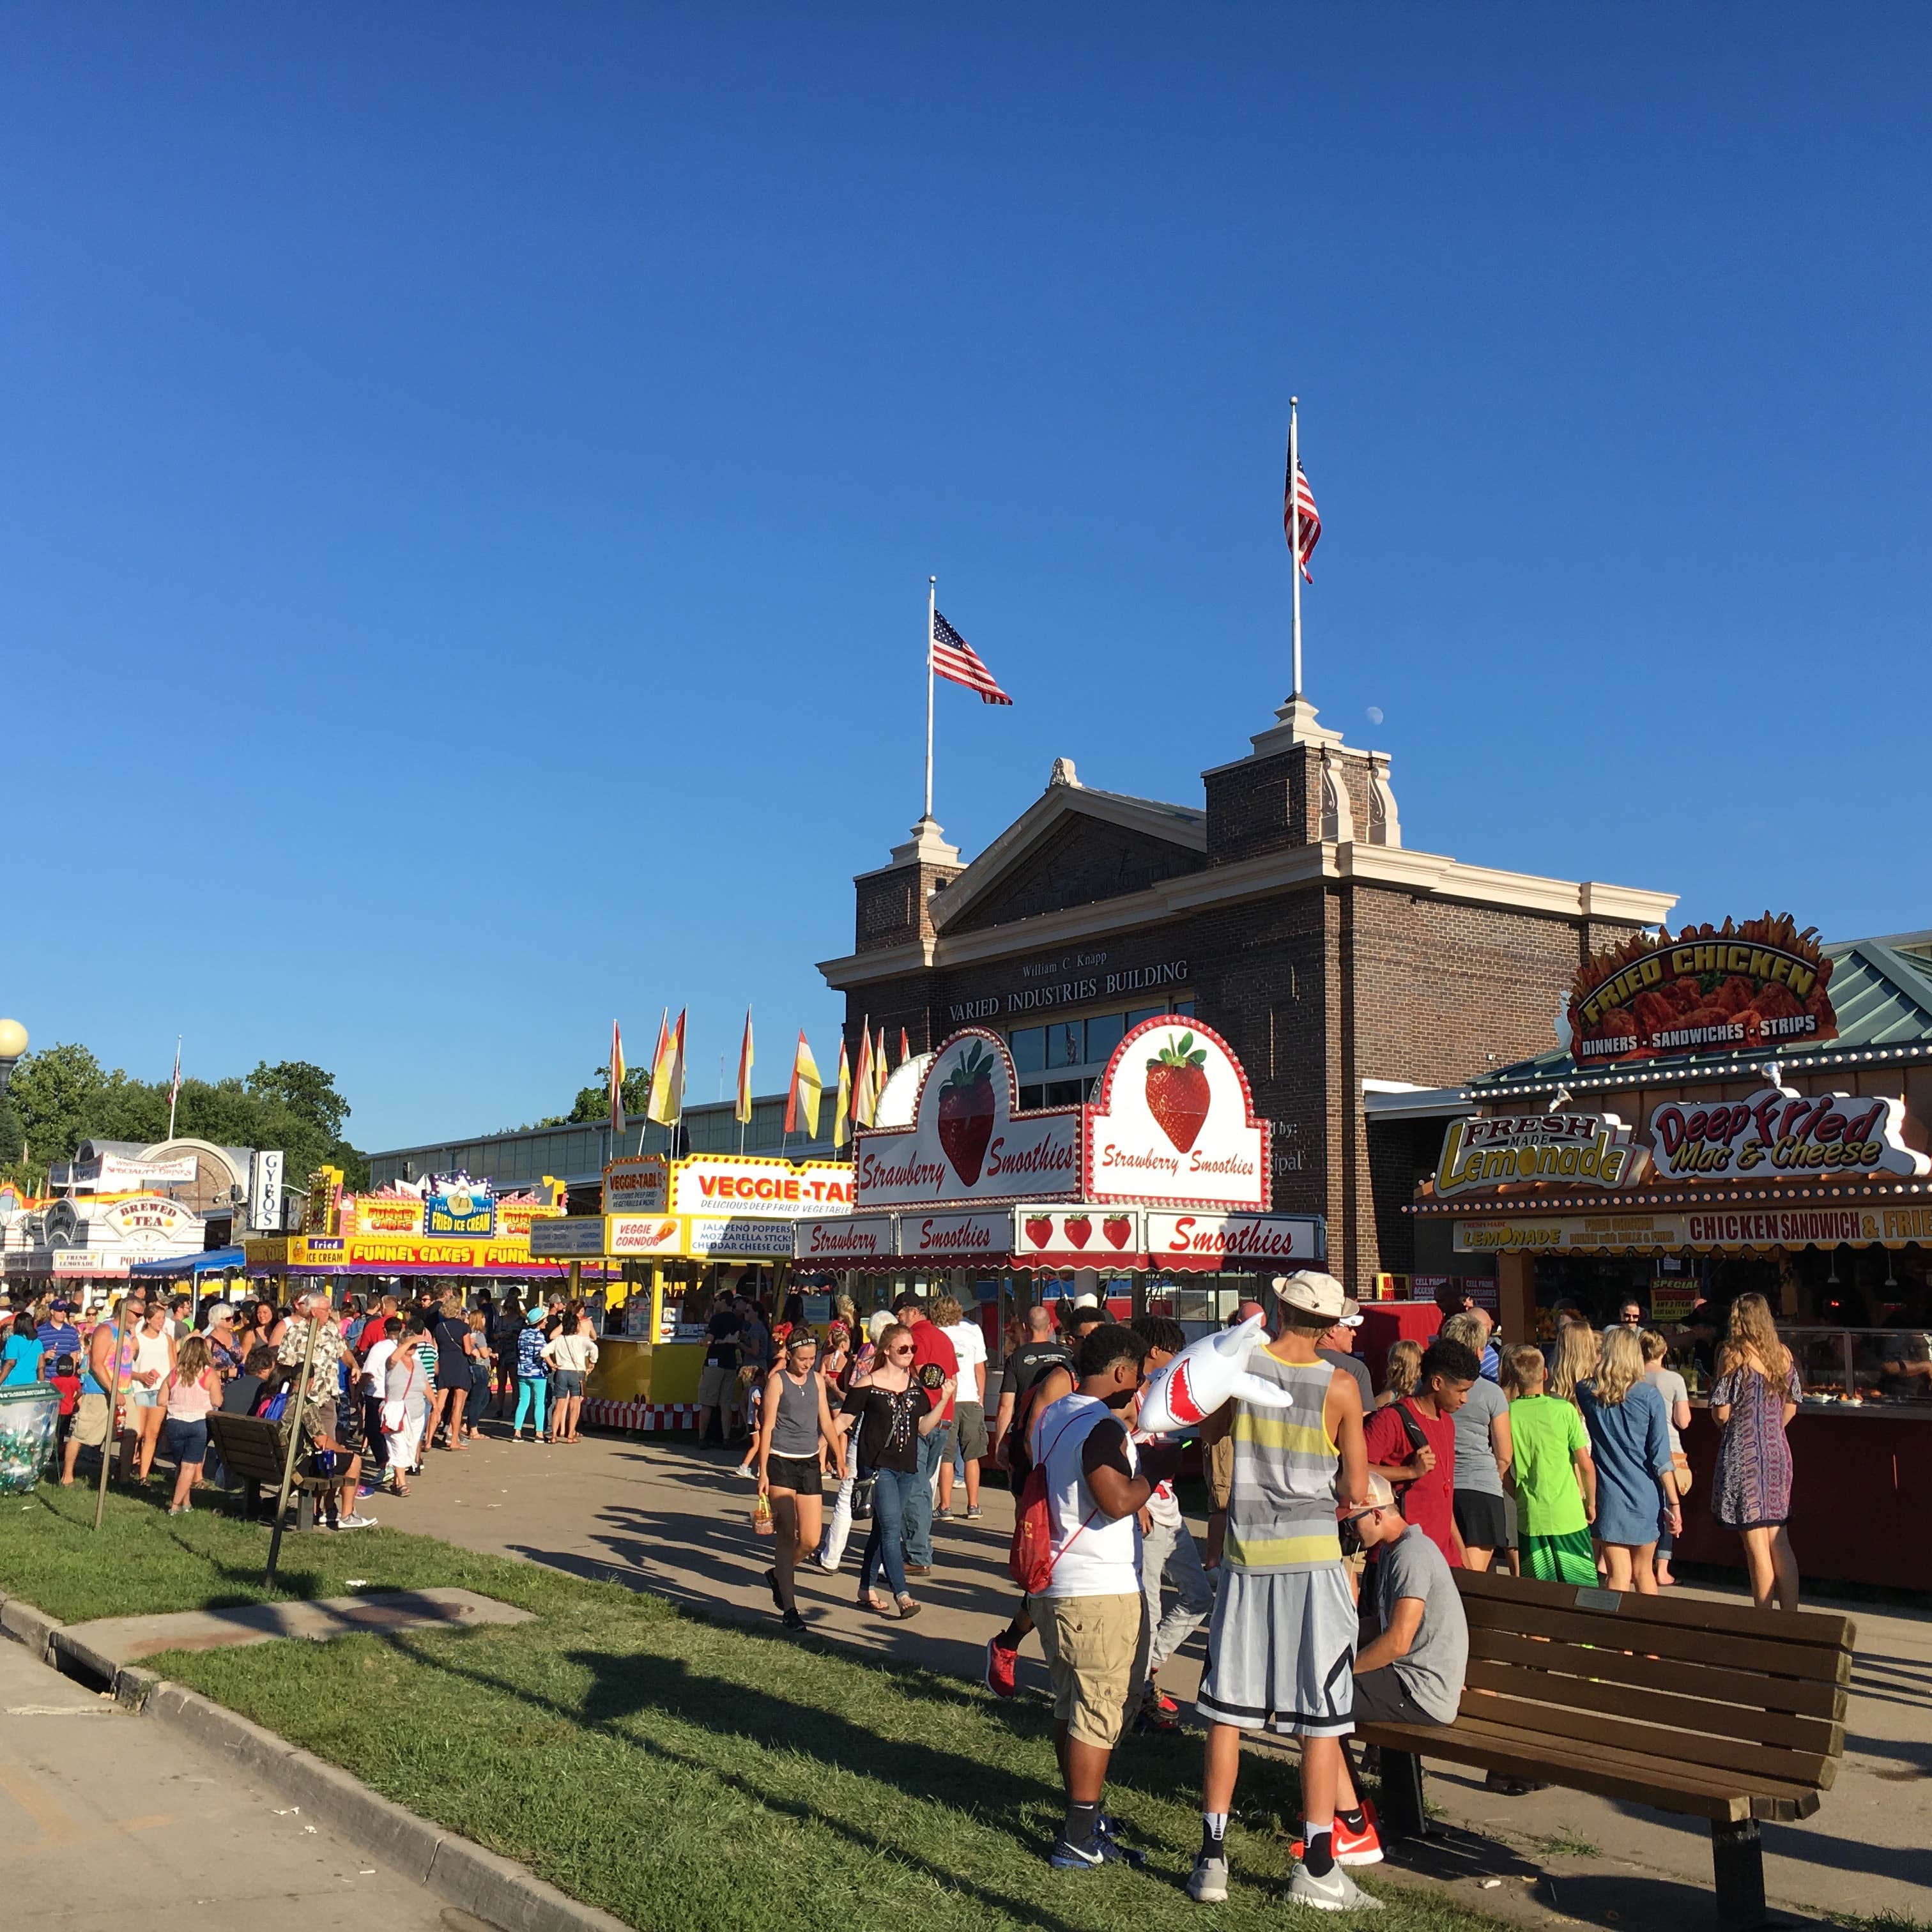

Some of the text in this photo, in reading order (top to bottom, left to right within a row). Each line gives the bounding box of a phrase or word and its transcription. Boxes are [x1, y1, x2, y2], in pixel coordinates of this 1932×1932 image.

[1023, 962, 1057, 977] William
[1077, 952, 1107, 967] Knapp
[949, 960, 1188, 1022] VARIED INDUSTRIES BUILDING
[1583, 945, 1816, 1023] FRIED CHICKEN
[1582, 1015, 1816, 1056] DINNERS SANDWICHES STRIPS
[1279, 1121, 1297, 1138] by:
[1464, 1116, 1598, 1148] FRESH
[1656, 1092, 1885, 1157] Deep Fried
[1510, 1134, 1549, 1146] MADE
[1102, 1144, 1254, 1177] Strawberry Smoothies
[1669, 1133, 1883, 1174] Mac & Cheese
[861, 1132, 1074, 1195] Strawberry Smoothies
[263, 1154, 277, 1226] GYROS
[610, 1172, 663, 1191] VEGGIE-TABLE
[119, 1202, 177, 1217] BREWED
[368, 1208, 418, 1221] FUNNEL
[473, 1205, 491, 1213] grande
[701, 1199, 747, 1210] DELICIOUS
[749, 1200, 772, 1211] DEEP
[774, 1202, 799, 1212] FRIED
[133, 1216, 163, 1227] TEA
[372, 1220, 413, 1232] CAKES
[432, 1211, 491, 1232] FRIED ICE CREAM
[620, 1224, 652, 1234] VEGGIE
[753, 1225, 790, 1233] POPPERS
[1689, 1215, 1780, 1241] CHICKEN
[1780, 1211, 1860, 1240] SANDWICH
[1862, 1215, 1880, 1239] &
[616, 1236, 660, 1246] CORNDOG
[700, 1233, 762, 1241] MOZZARELLA
[810, 1223, 877, 1254] Strawberry
[920, 1217, 991, 1250] Smoothies
[1169, 1216, 1294, 1256] Smoothies
[1462, 1227, 1561, 1246] LEMONADE
[314, 1241, 338, 1249] fried
[353, 1244, 471, 1263] FUNNEL CAKES
[692, 1241, 737, 1250] CHEDDAR
[739, 1243, 770, 1251] CHEESE
[306, 1253, 343, 1263] ICE CREAM
[1466, 1280, 1478, 1288] CELL
[1652, 1280, 1698, 1289] SPECIAL
